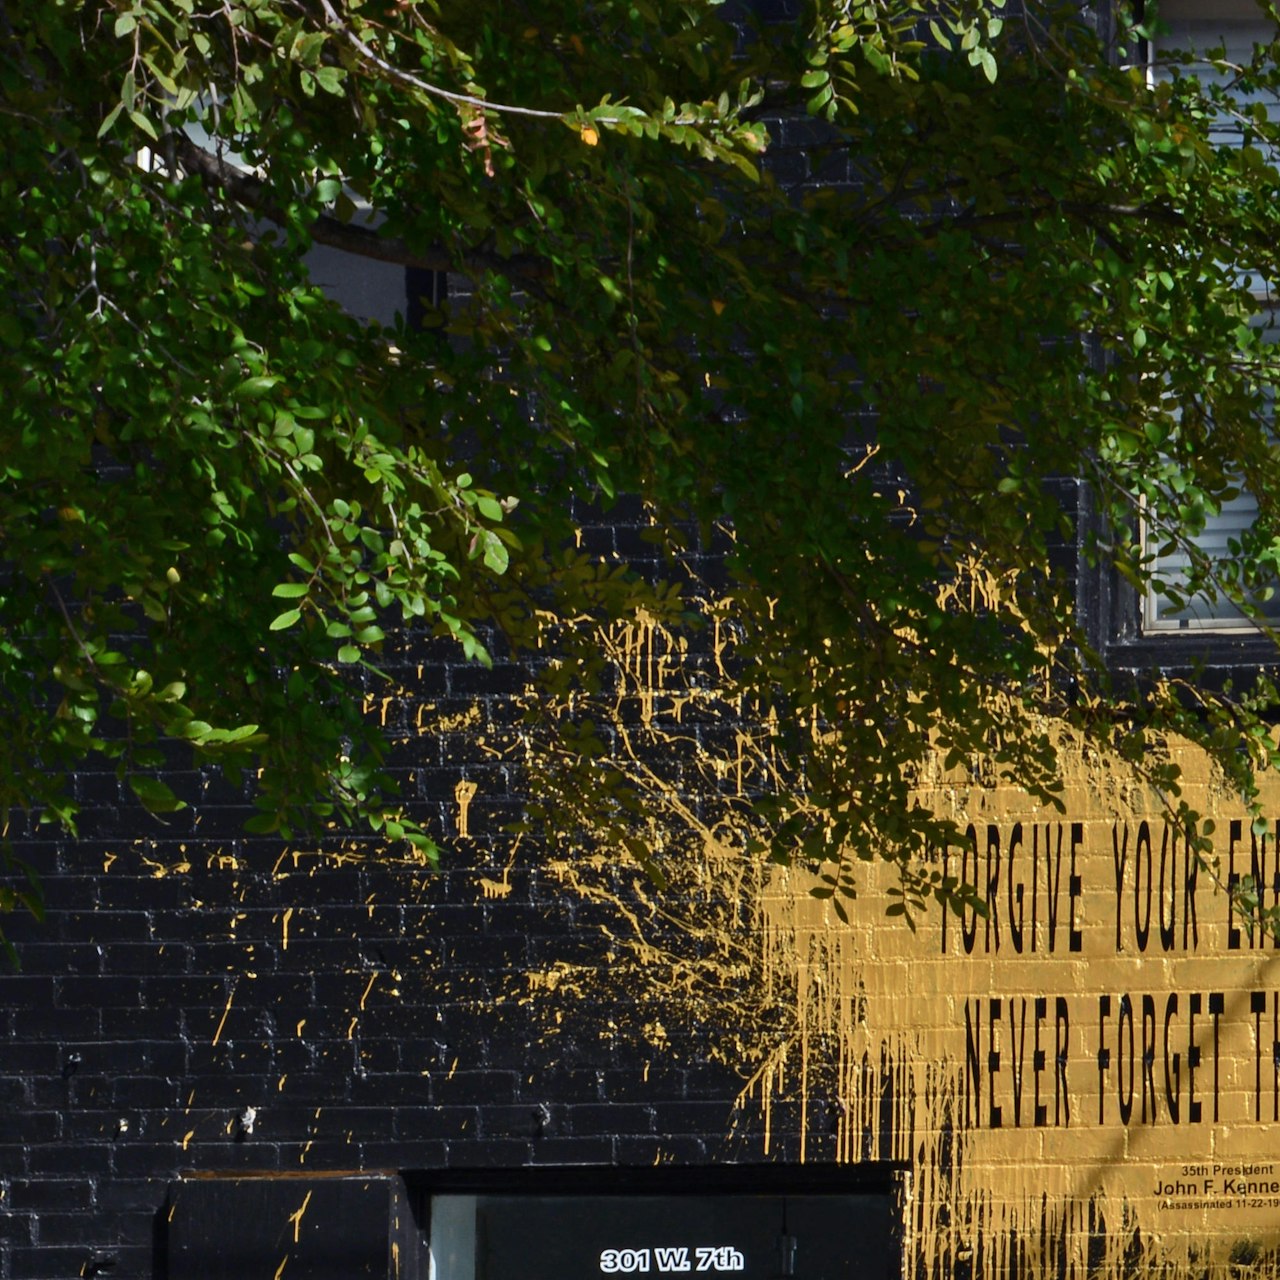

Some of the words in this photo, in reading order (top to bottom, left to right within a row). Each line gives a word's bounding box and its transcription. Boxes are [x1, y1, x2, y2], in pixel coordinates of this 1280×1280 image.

[1112, 817, 1198, 953] YOUR
[964, 996, 1070, 1129] NEVER
[1097, 992, 1225, 1127] FORGET
[1181, 1165, 1209, 1177] 35th
[1213, 1164, 1274, 1176] President
[1153, 1180, 1198, 1196] John
[1203, 1179, 1218, 1195] F.
[1157, 1199, 1233, 1213] (Assassinated
[600, 1248, 650, 1273] 301
[654, 1247, 691, 1272] W.
[695, 1246, 744, 1271] 7th
